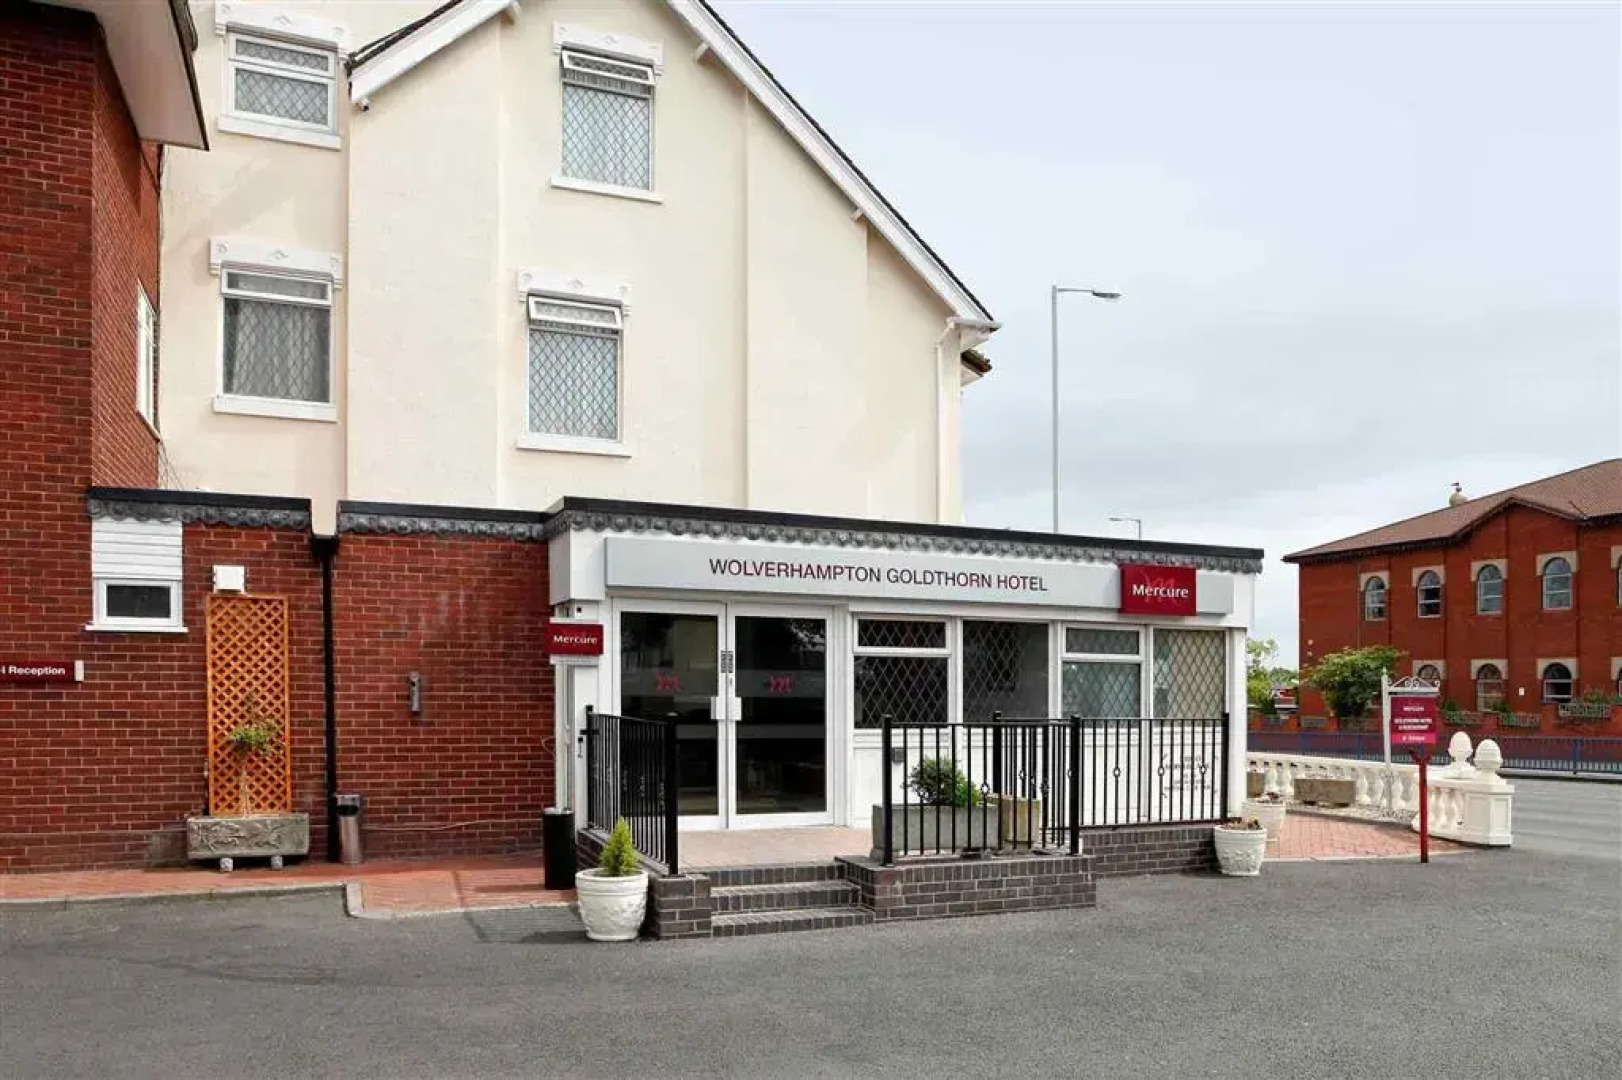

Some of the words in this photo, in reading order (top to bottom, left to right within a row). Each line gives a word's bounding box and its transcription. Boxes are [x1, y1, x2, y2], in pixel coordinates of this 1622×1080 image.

[709, 558, 882, 583] WOLVERHAMPTON
[886, 568, 992, 589] GOLDTHORN
[997, 574, 1048, 592] HOTEL
[1132, 583, 1189, 598] Mercure
[553, 634, 598, 644] Mercure
[8, 665, 66, 676] Reception
